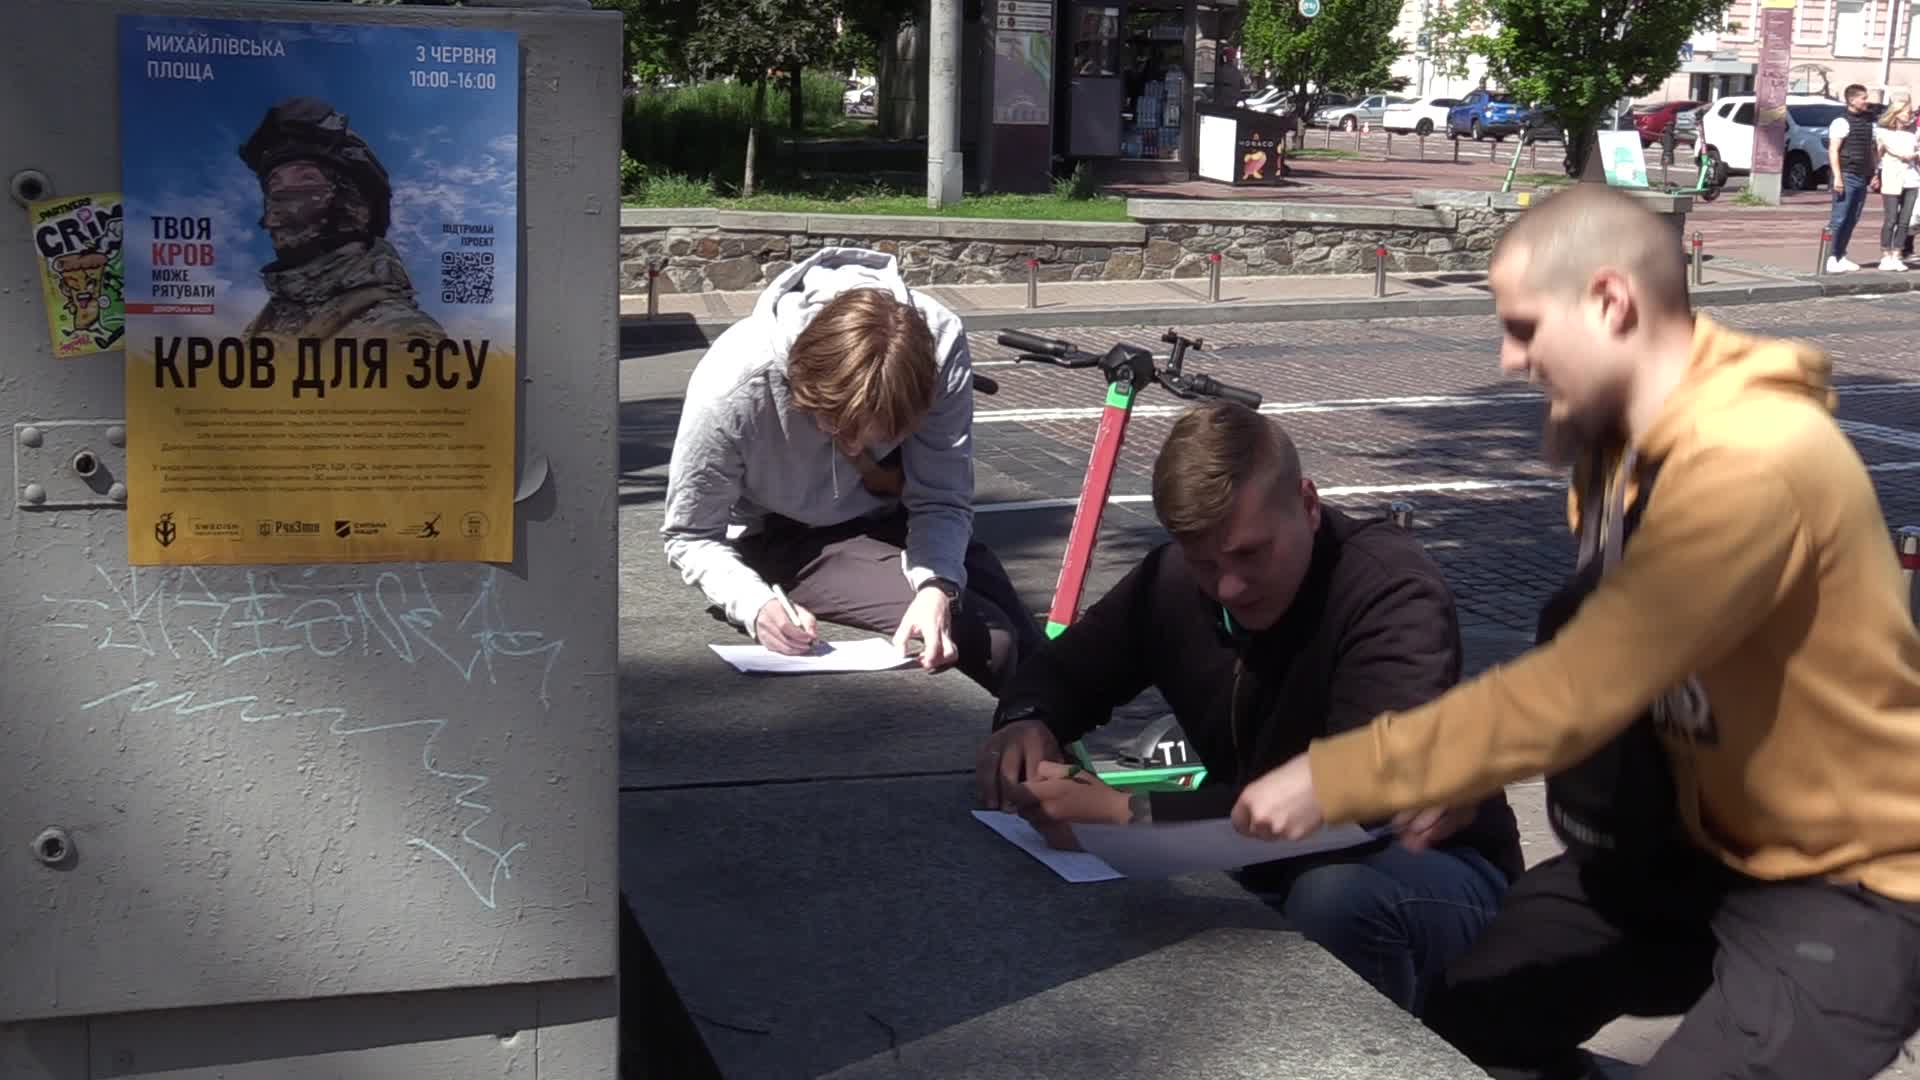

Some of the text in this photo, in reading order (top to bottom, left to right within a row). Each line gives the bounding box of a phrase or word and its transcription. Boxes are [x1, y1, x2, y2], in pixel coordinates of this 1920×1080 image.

[146, 33, 286, 57] МИХАЙЛІВСЬКА
[416, 45, 497, 65] 3 ЧЕРВНЯ
[146, 60, 215, 82] ПЛОЩА
[151, 216, 212, 241] ТВОЯ
[152, 243, 215, 267] КРОВ
[152, 269, 190, 282] МОЖЕ
[152, 284, 216, 300] РЯТУВАТИ
[155, 336, 275, 389] КРОВ
[292, 338, 388, 399] ДЛЯ
[1157, 740, 1187, 766] T1
